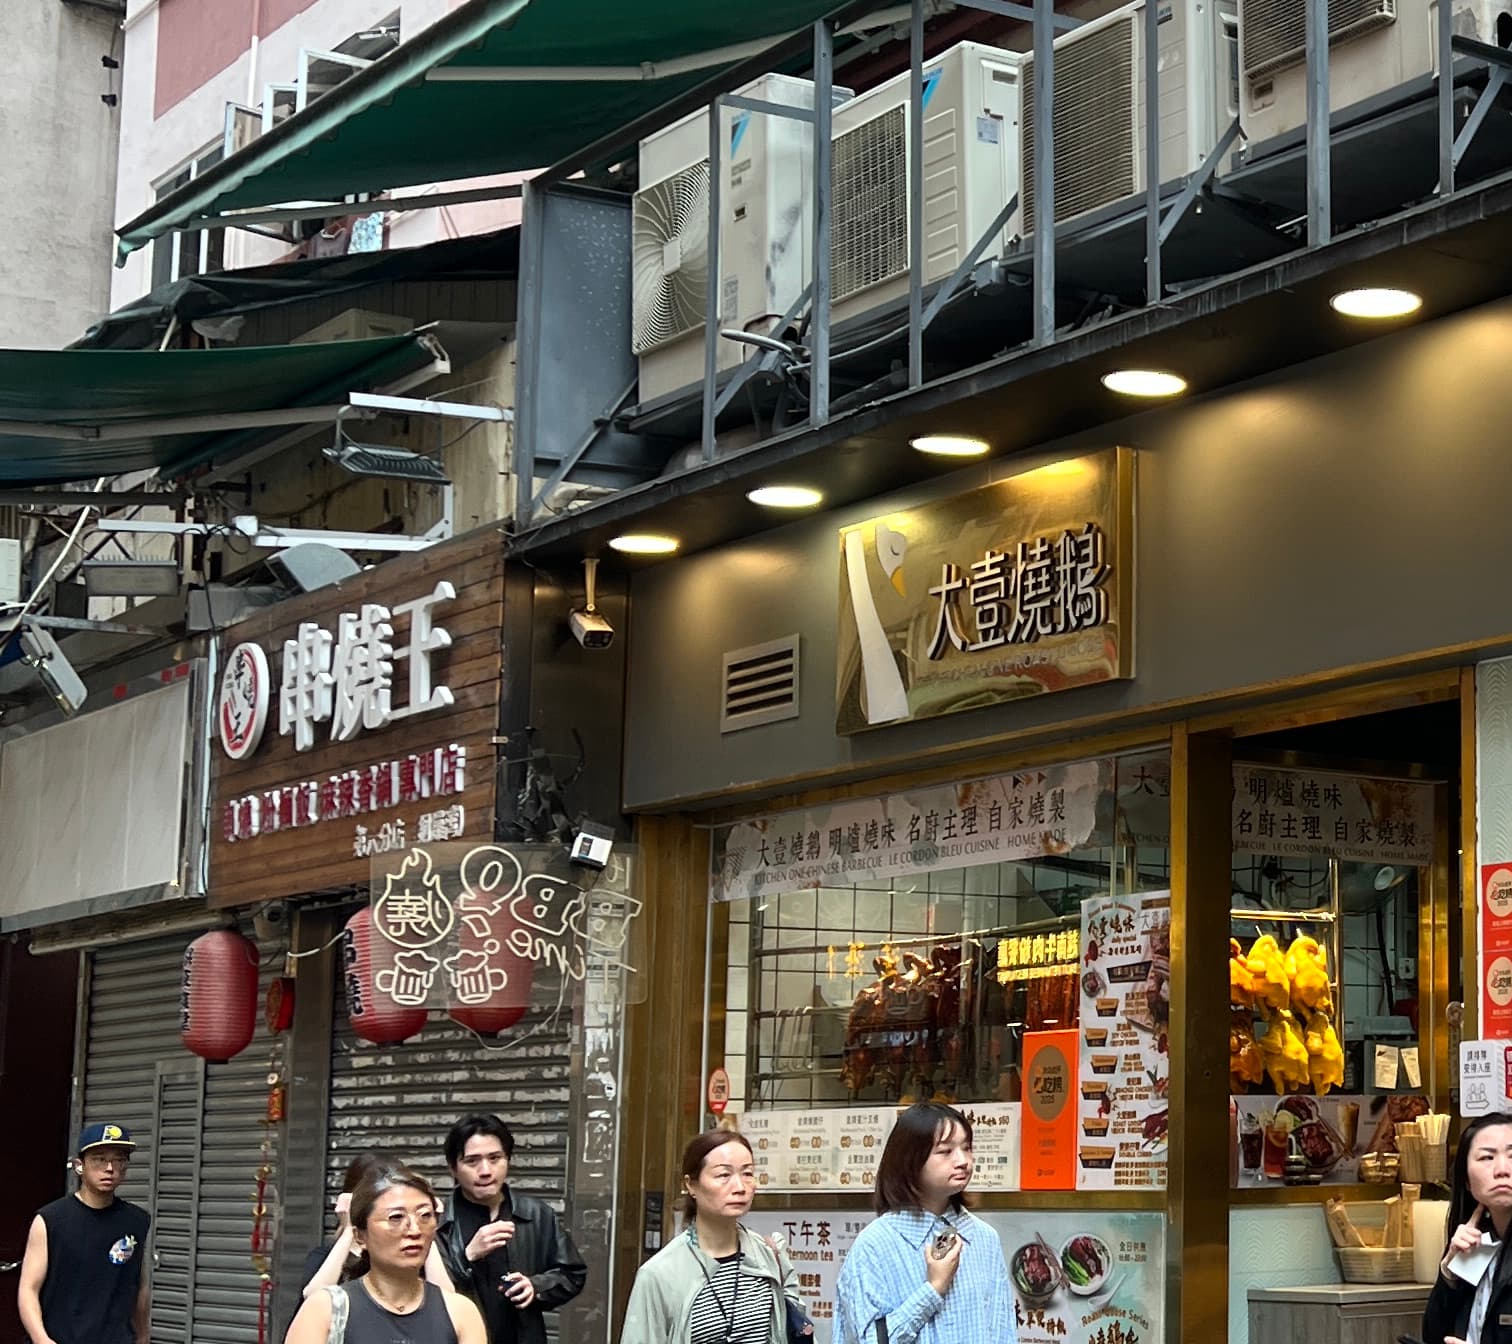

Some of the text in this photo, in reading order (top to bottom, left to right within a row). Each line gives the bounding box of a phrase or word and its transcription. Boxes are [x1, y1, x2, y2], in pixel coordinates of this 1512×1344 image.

[927, 522, 1111, 660] 大壹燒鵝
[279, 581, 456, 752] 串燒王
[757, 830, 821, 868] 大壹燒鵝
[906, 805, 979, 845] 名廚主理
[988, 788, 1066, 831] 自家燒製
[1236, 808, 1322, 840] 名廚主理
[842, 855, 883, 875] BARBECUE
[888, 854, 897, 866] LE
[899, 846, 939, 865] CORDON
[940, 843, 963, 858] BLEU
[964, 839, 1000, 854] CUISINE
[1007, 834, 1036, 848] HOME
[783, 1220, 831, 1247] 下午茶
[820, 1250, 834, 1262] tea
